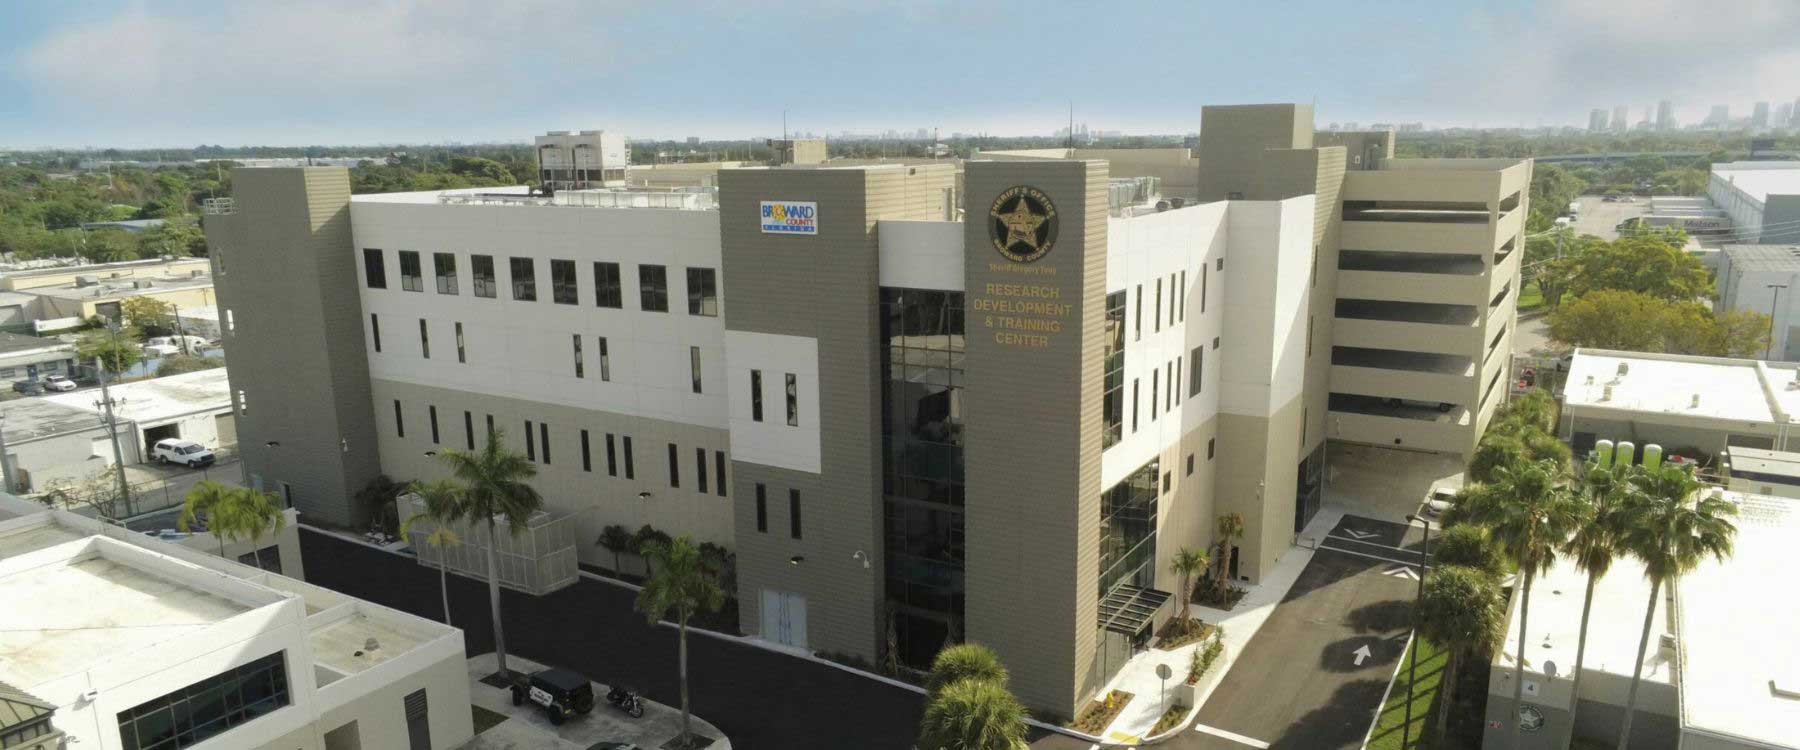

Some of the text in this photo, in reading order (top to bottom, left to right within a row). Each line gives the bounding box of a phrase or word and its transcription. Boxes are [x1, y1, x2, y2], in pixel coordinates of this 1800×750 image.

[762, 204, 814, 218] BROWARD
[1030, 190, 1056, 219] OFFICE
[993, 238, 1052, 262] BROWARD COUNTY
[986, 283, 1060, 298] RESEARCH
[974, 299, 1072, 317] DEVELOPMENT
[985, 316, 1062, 332] & TRAINING
[995, 332, 1048, 346] CENTER
